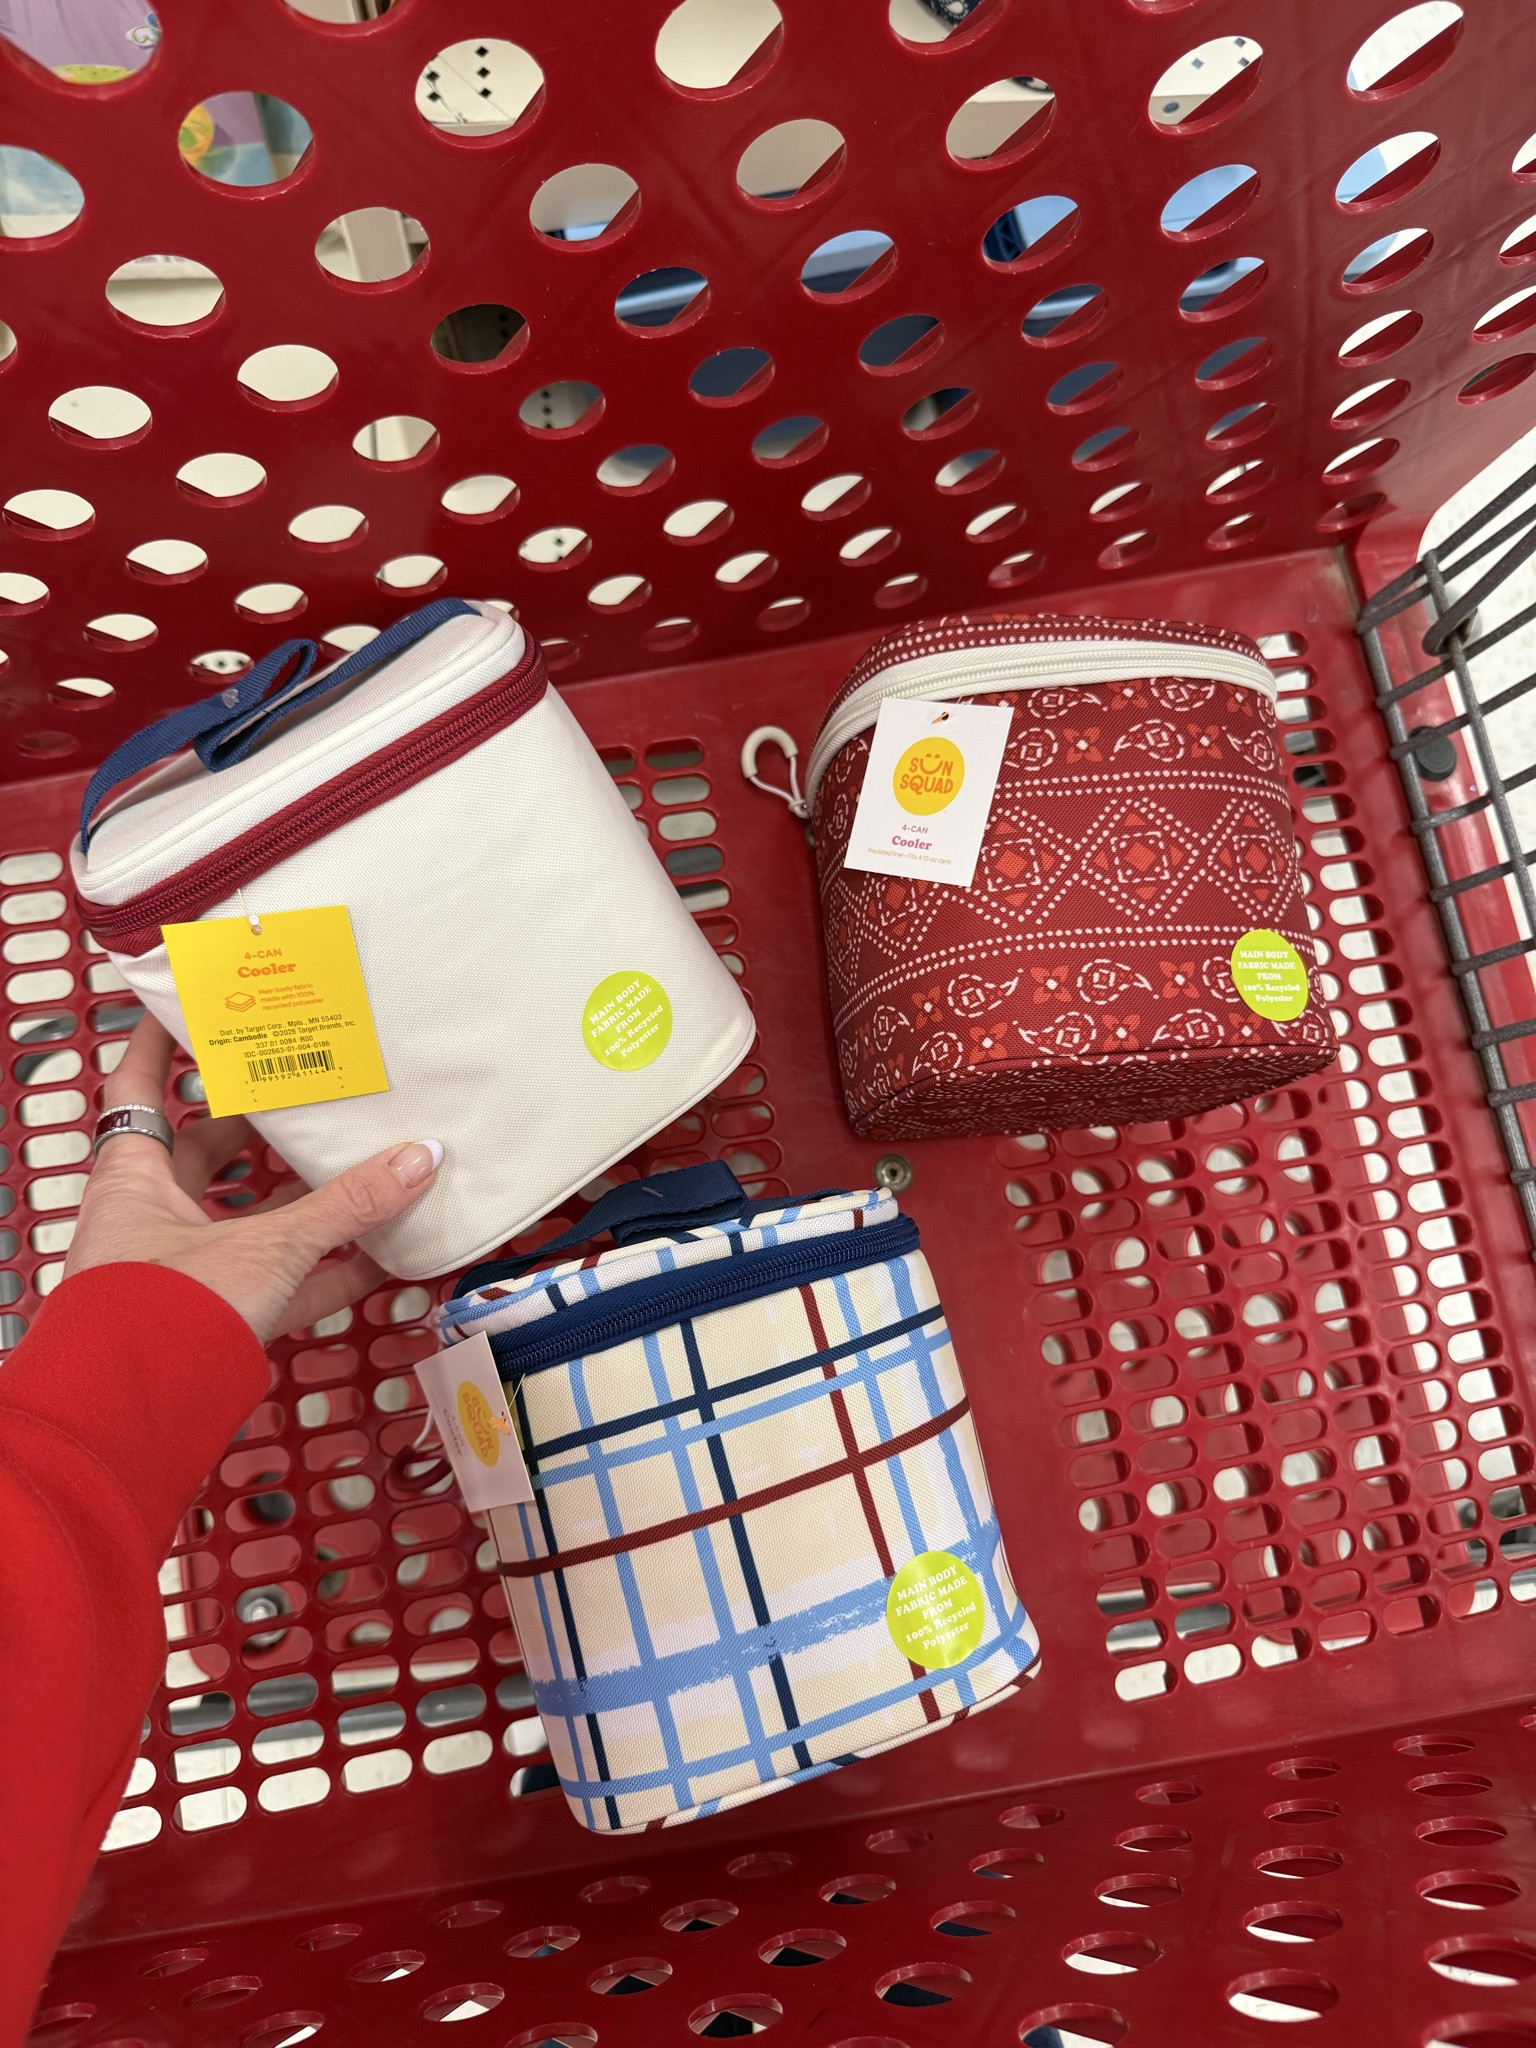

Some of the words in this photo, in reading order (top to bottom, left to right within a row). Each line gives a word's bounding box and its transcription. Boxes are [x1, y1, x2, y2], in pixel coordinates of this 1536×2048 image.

[909, 757, 954, 777] SUN
[899, 774, 954, 796] SQUAD
[901, 824, 929, 834] 4-CAN
[891, 835, 932, 850] Cooler
[244, 948, 282, 961] 4-CAN
[1239, 950, 1263, 959] MAIN
[1265, 951, 1289, 959] BODY
[237, 963, 296, 978] Cooler
[1237, 961, 1269, 970] FABRIC
[1270, 962, 1296, 970] MADE
[1256, 972, 1282, 980] FROM
[296, 990, 315, 998] 100%
[1255, 994, 1294, 1003] Polyester
[1265, 983, 1301, 993] Recycled
[262, 1002, 291, 1011] recycled
[292, 998, 324, 1008] polyester
[589, 1000, 616, 1025] MAIN
[615, 978, 640, 1003] BODY
[590, 1007, 626, 1038] FABRIC
[625, 984, 652, 1010] MADE
[219, 1029, 234, 1037] Dist.
[236, 1027, 244, 1036] by
[245, 1025, 266, 1033] Target
[320, 1014, 343, 1022] 55403
[604, 1036, 627, 1056] 100%
[627, 1004, 664, 1038] Recycled
[614, 1008, 642, 1033] FROM
[208, 1037, 232, 1046] Origin:
[233, 1032, 268, 1043] Cambodia
[298, 1025, 319, 1034] Target
[319, 1022, 344, 1031] Brands,
[344, 1019, 357, 1027] Inc.
[255, 1041, 268, 1049] 337
[279, 1037, 297, 1046] 0084
[620, 1023, 659, 1058] Polyester
[262, 1073, 292, 1083] 99592
[296, 1068, 326, 1078] 61144
[462, 1392, 489, 1458] SQUAD
[896, 1581, 928, 1601] MAIN
[928, 1564, 957, 1586] BODY
[895, 1591, 937, 1617] FABRIC
[937, 1575, 968, 1597] MADE
[921, 1597, 954, 1620] FROM
[905, 1623, 933, 1643] 100%
[933, 1601, 977, 1630] Recycled
[922, 1622, 969, 1650] Polyester
